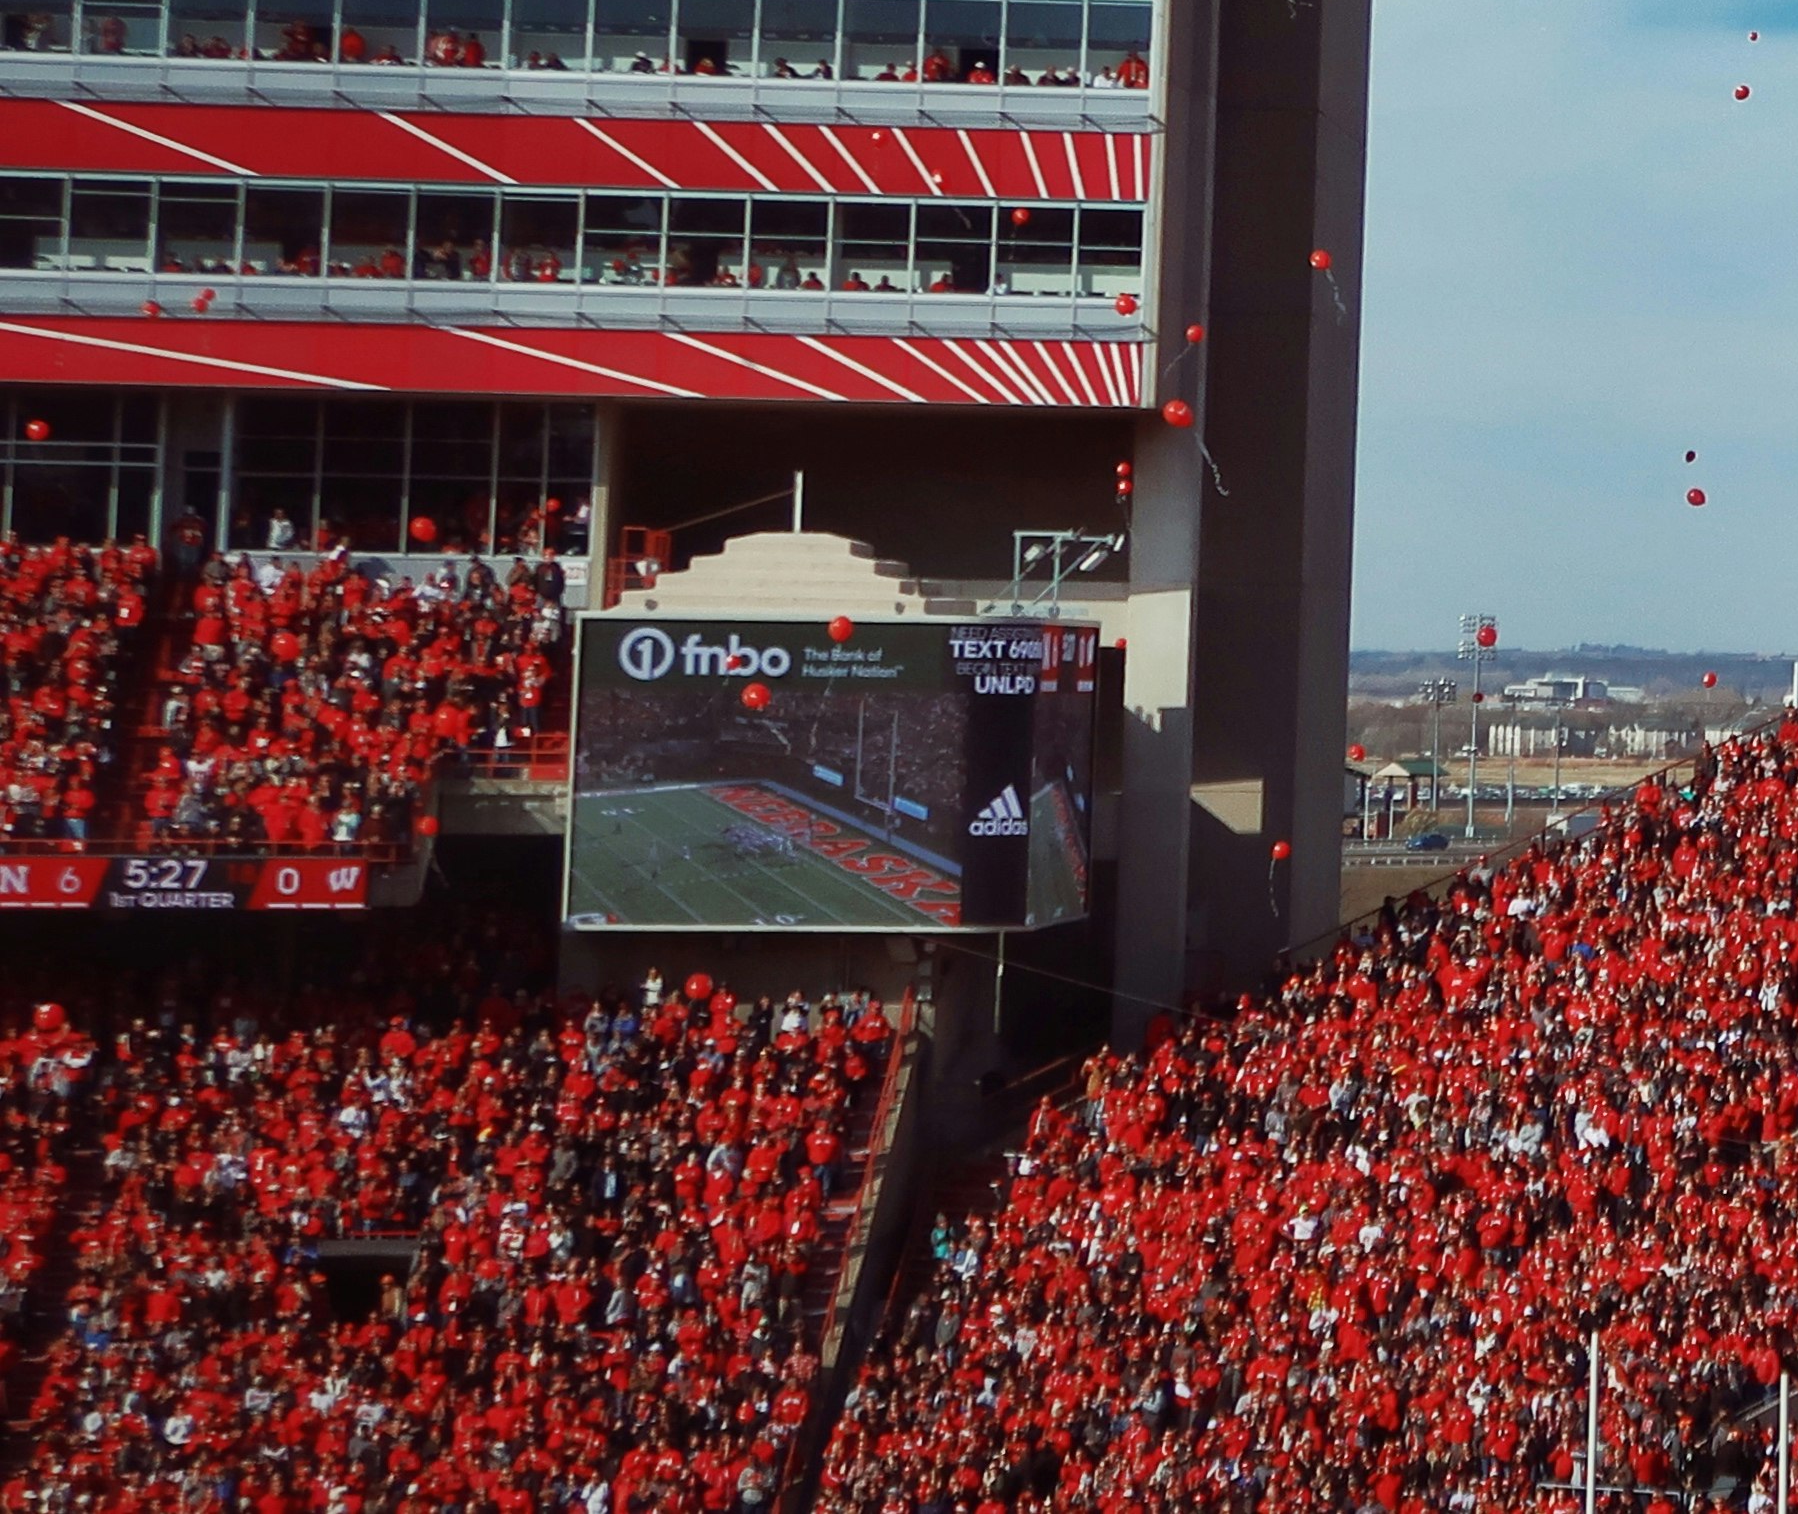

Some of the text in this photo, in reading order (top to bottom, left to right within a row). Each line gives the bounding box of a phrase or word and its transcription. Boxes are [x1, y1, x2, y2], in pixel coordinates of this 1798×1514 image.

[681, 633, 792, 678] fnbo
[949, 639, 1006, 659] TEXT
[968, 818, 1029, 836] adidas
[59, 869, 82, 894] 6
[123, 859, 209, 889] 5:27
[277, 867, 299, 895] 0
[110, 892, 236, 908] 1ST QUARTER
